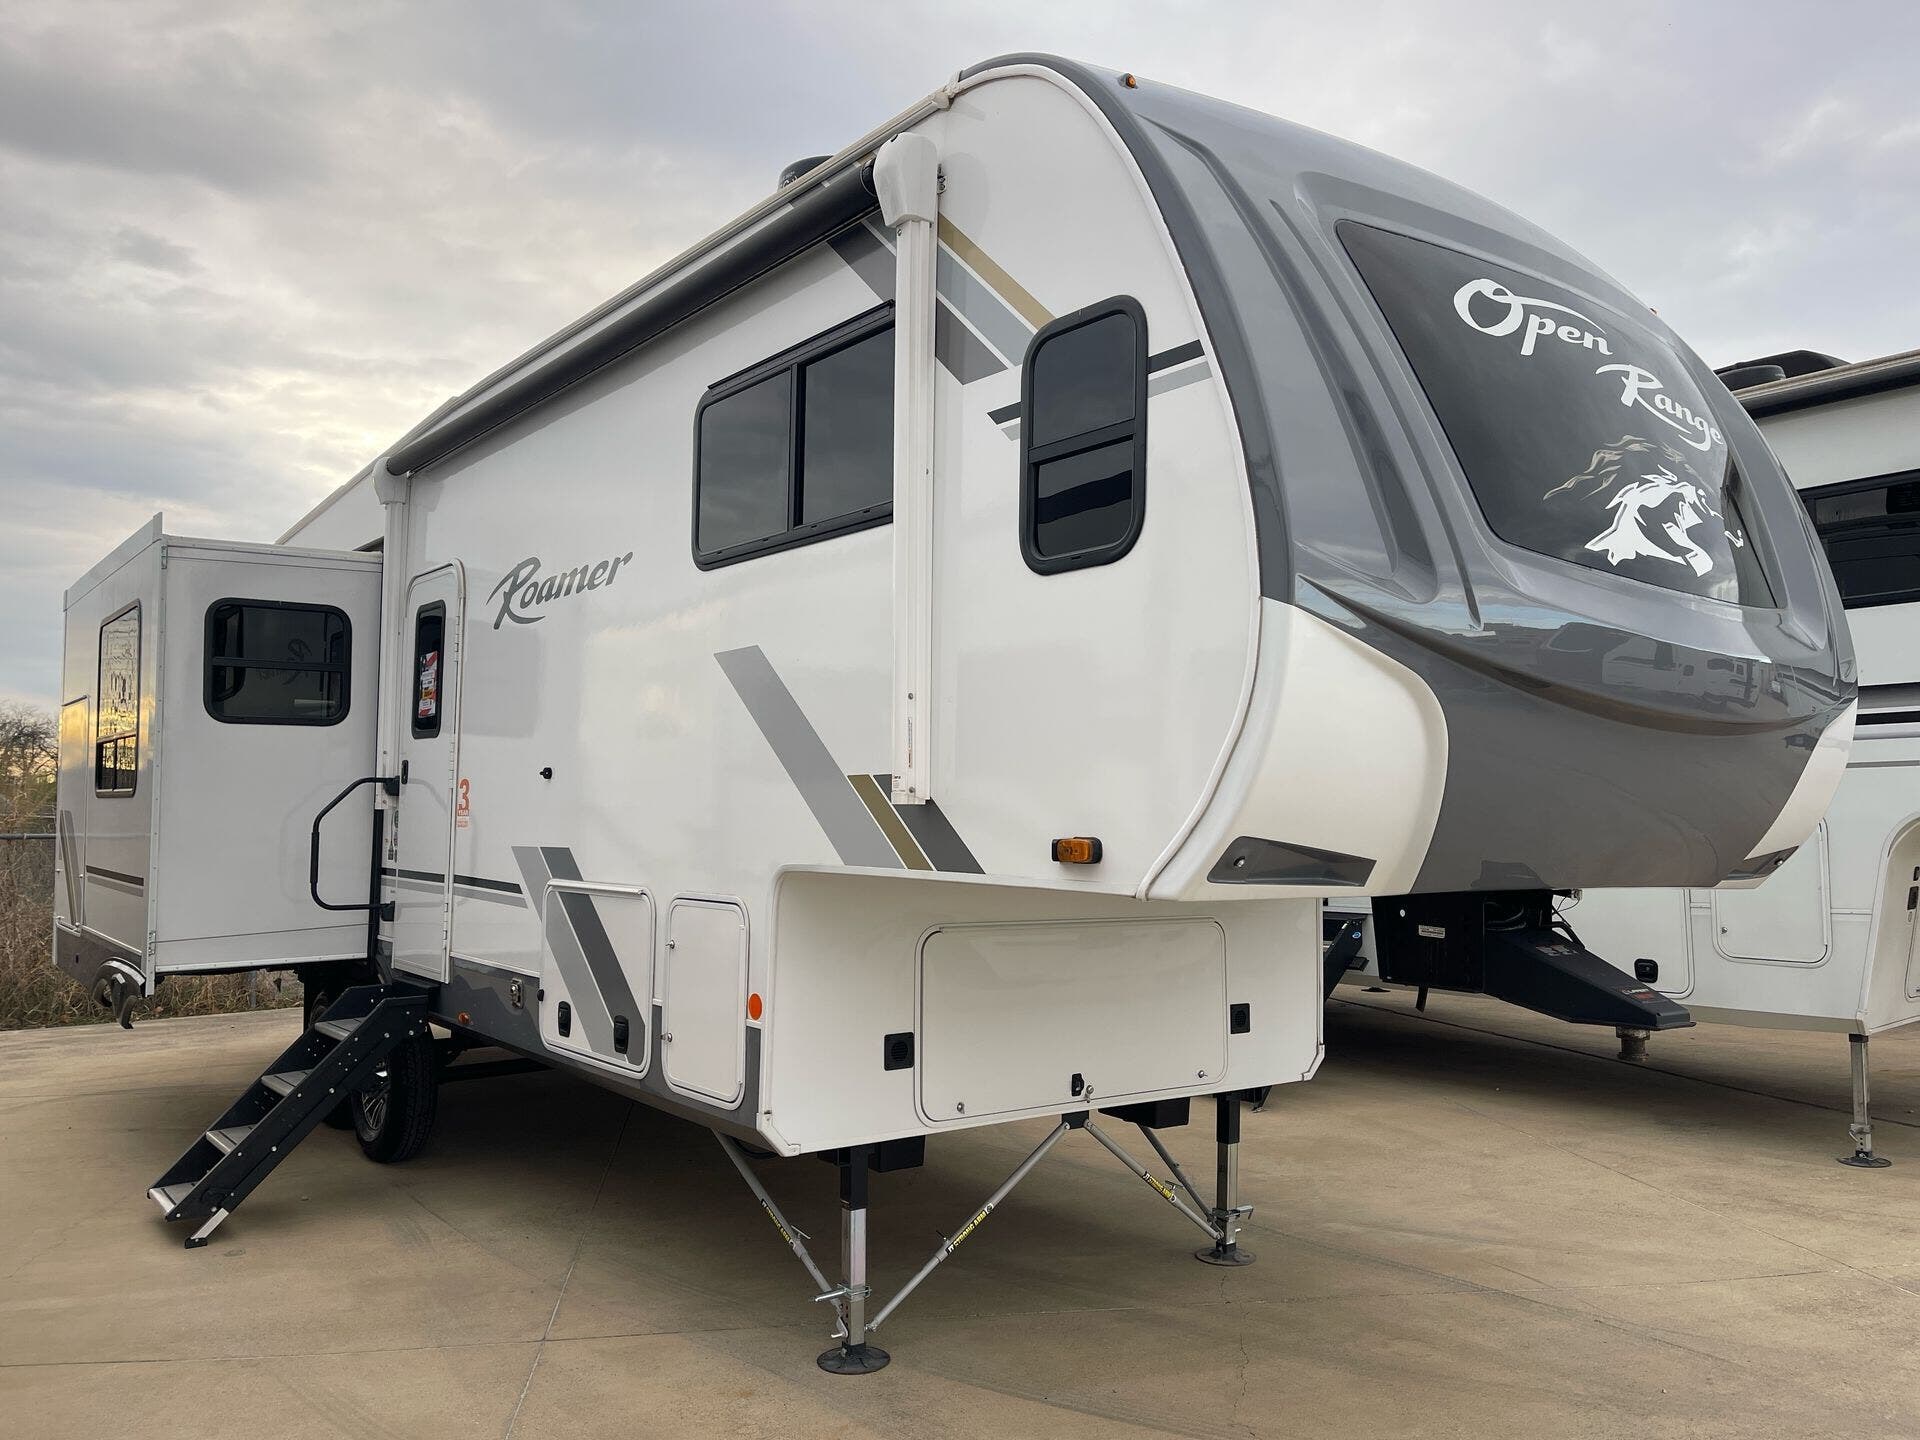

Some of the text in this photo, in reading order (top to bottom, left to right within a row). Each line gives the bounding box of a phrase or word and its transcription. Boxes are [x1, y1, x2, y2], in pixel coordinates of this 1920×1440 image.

[1453, 278, 1613, 356] Open
[1595, 363, 1724, 452] Range
[486, 551, 634, 630] Roamer
[459, 778, 470, 810] 3
